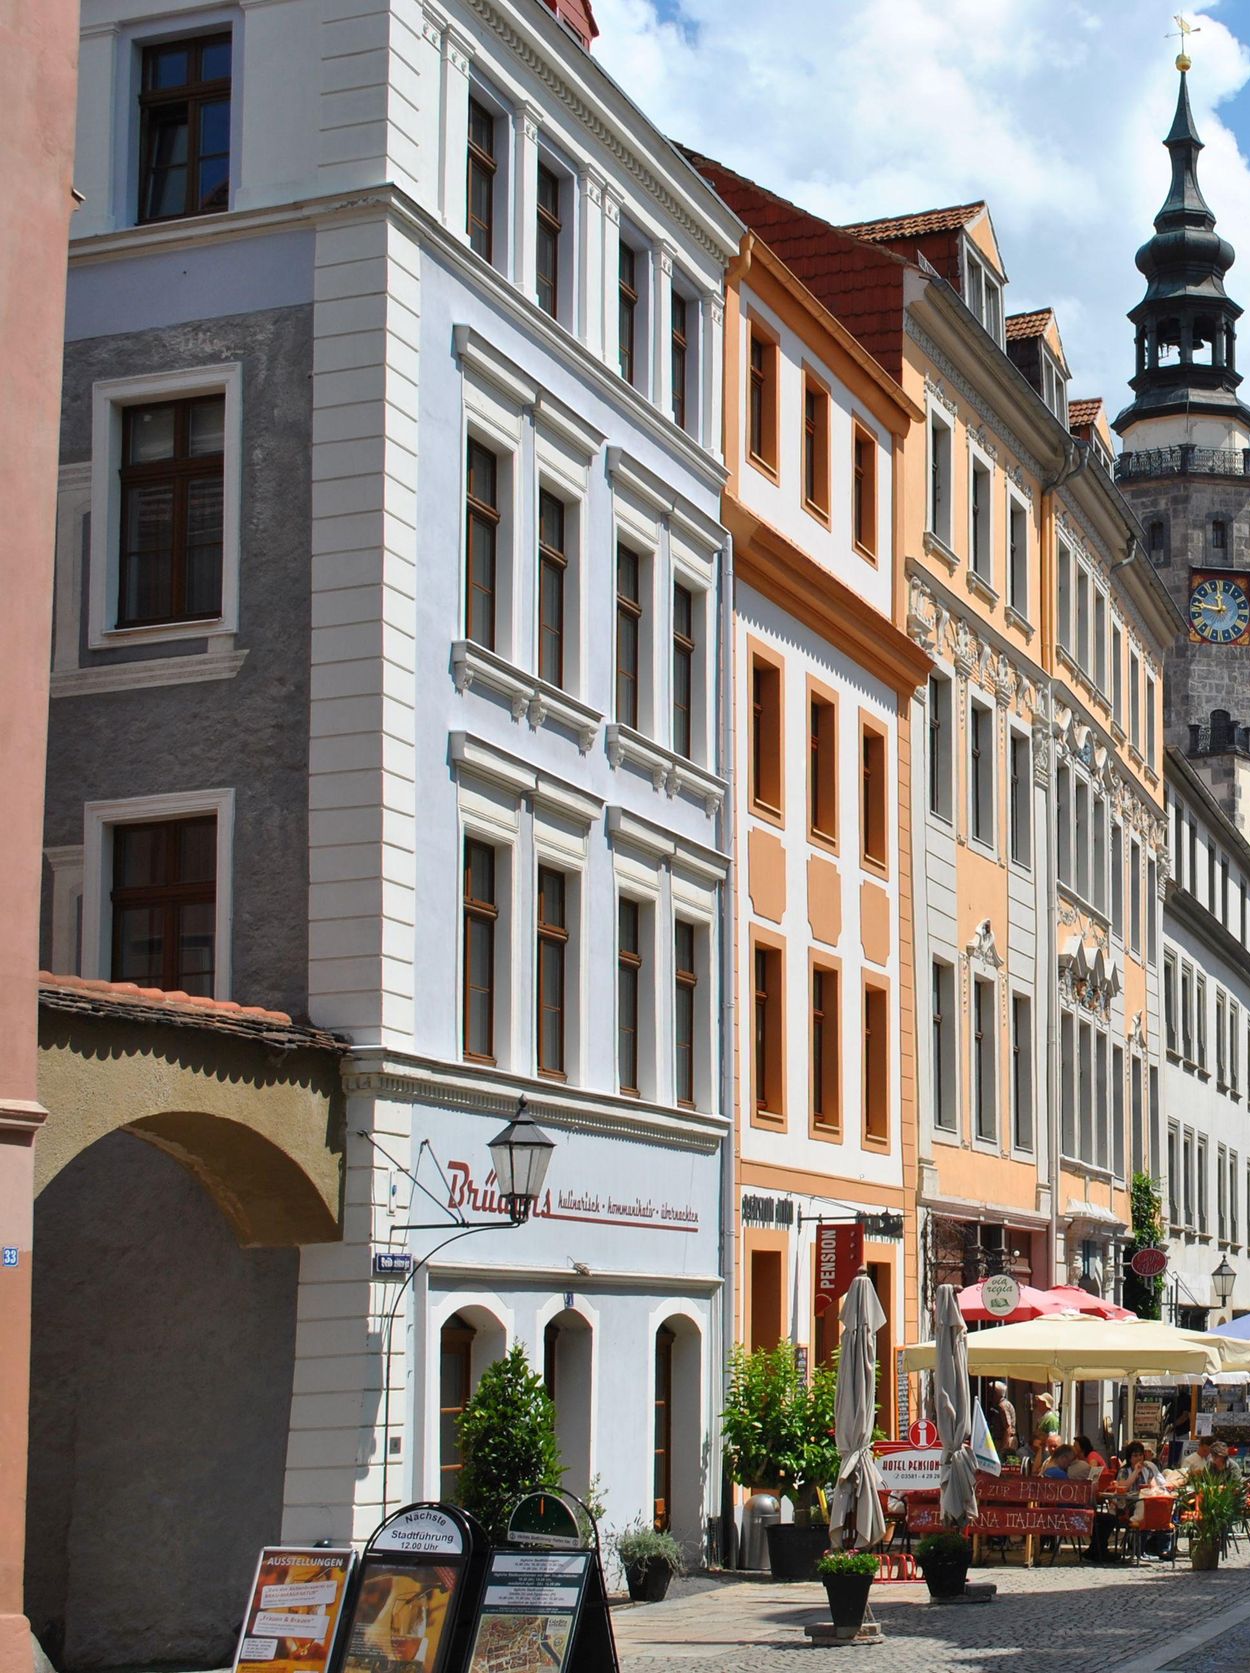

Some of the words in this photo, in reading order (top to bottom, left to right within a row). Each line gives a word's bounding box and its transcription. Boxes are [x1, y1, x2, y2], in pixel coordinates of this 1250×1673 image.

[558, 1190, 600, 1213] kulinarisch
[607, 1196, 655, 1218] kommunikativ
[661, 1201, 699, 1223] übernachten
[4, 1249, 16, 1264] 33
[820, 1230, 837, 1289] PENSION
[991, 1277, 1008, 1287] via
[987, 1286, 1013, 1296] regia
[882, 1460, 905, 1471] HOTEL
[908, 1460, 940, 1471] PENSION
[1019, 1482, 1088, 1504] PENSION
[405, 1511, 447, 1527] Nächste
[1006, 1512, 1070, 1531] ITALIANA
[391, 1530, 454, 1544] Stadtführung
[401, 1541, 422, 1550] 12.00
[266, 1556, 343, 1567] AUSSTELLUNGEN
